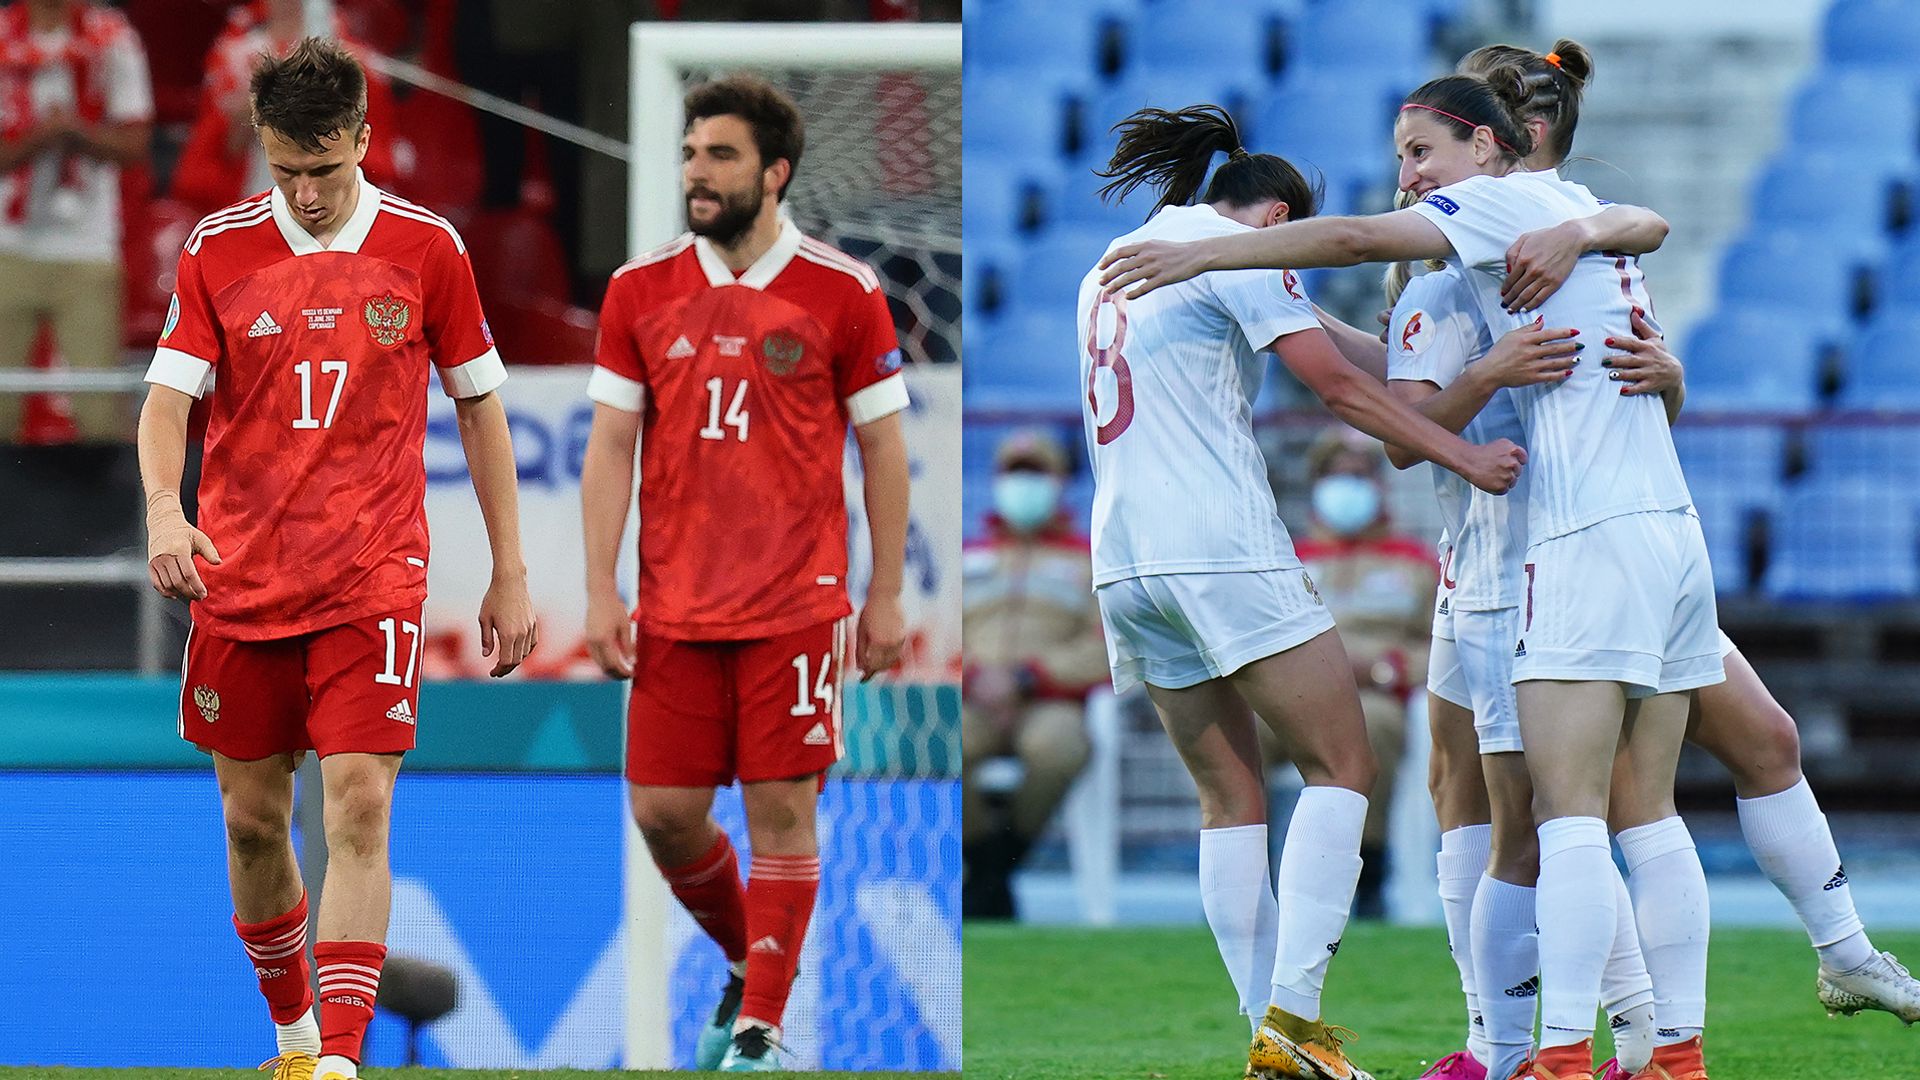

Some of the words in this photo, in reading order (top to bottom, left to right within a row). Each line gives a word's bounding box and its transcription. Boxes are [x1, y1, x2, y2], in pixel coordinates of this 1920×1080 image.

[1427, 195, 1457, 213] SPECT
[247, 325, 283, 338] adidas
[292, 360, 348, 430] 17
[1087, 288, 1135, 446] 8
[700, 377, 750, 443] 14
[374, 617, 420, 689] 17
[790, 652, 834, 717] 14
[386, 711, 415, 726] adidas
[327, 996, 366, 1008] adidas
